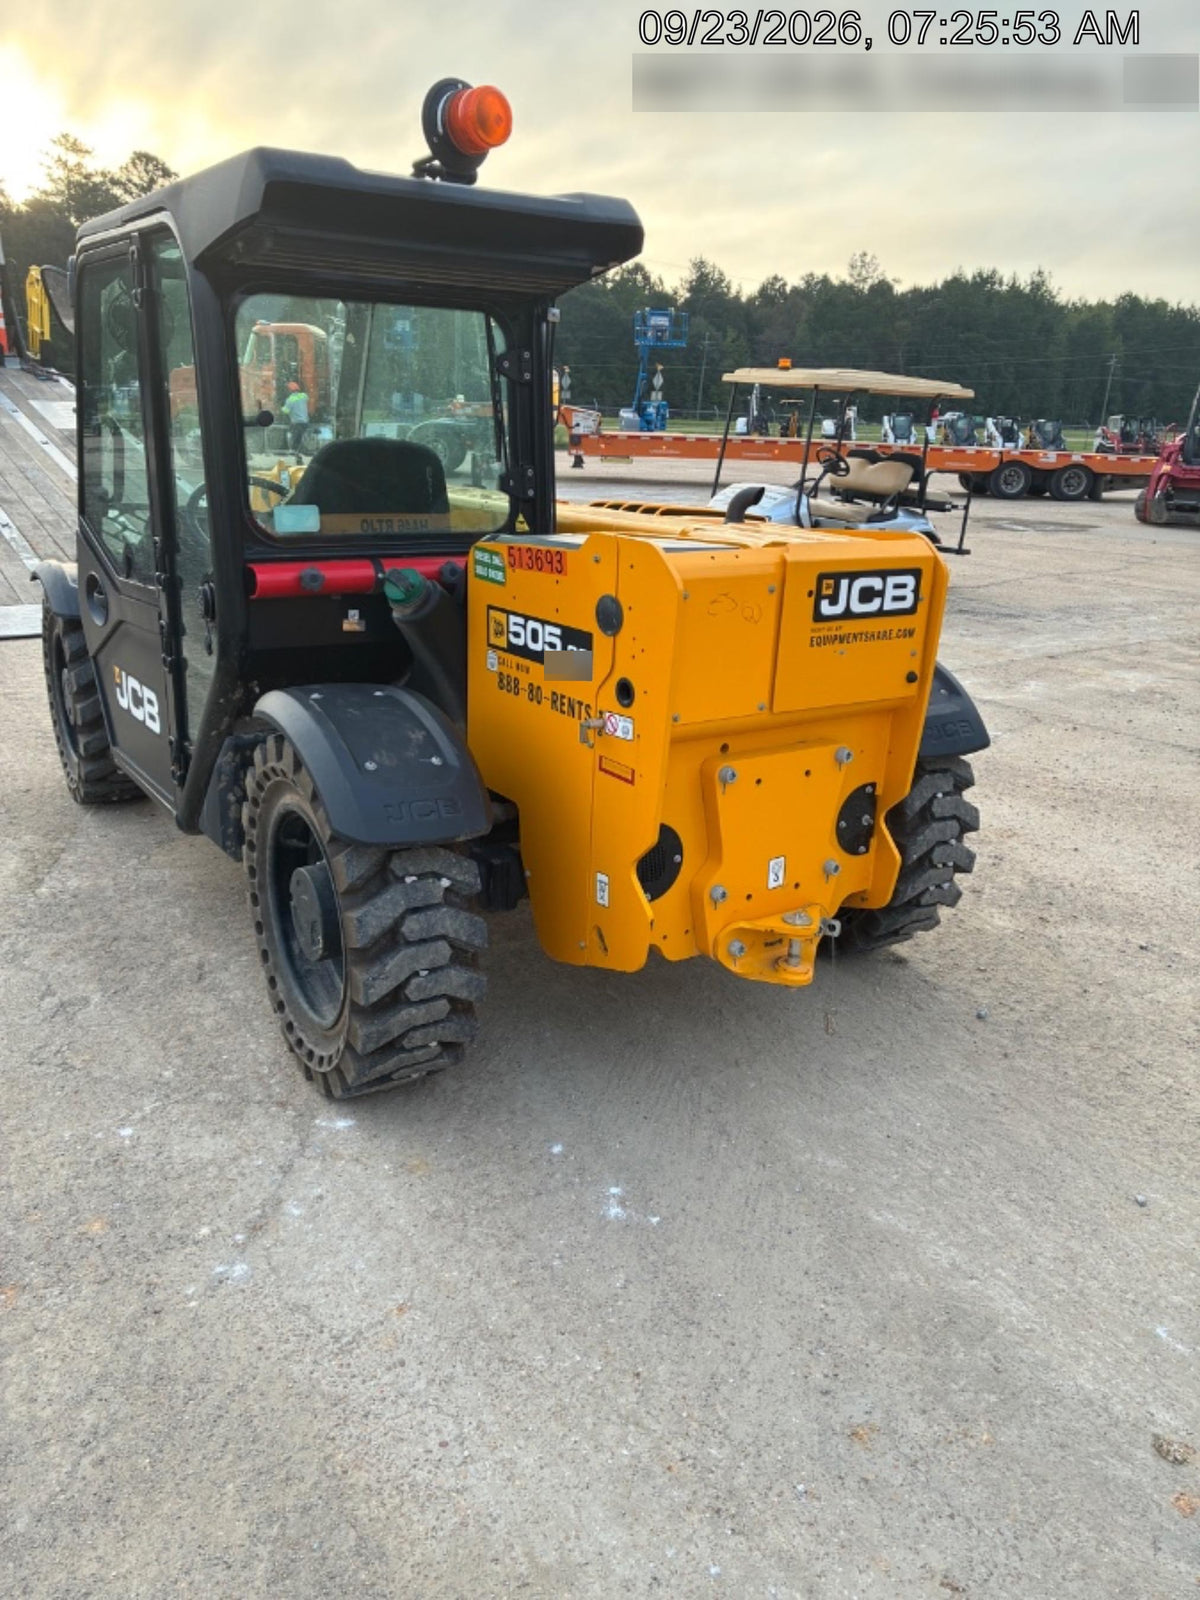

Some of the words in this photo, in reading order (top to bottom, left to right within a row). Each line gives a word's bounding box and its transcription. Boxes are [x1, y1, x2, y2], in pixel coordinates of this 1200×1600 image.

[507, 546, 563, 574] 513693
[820, 575, 916, 616] JCB
[508, 614, 562, 651] 505
[809, 627, 916, 648] EQUIPMENTSHARE.COM
[114, 667, 161, 735] JCB
[497, 671, 592, 721] 888-80-RENTS
[383, 799, 461, 822] JCB
